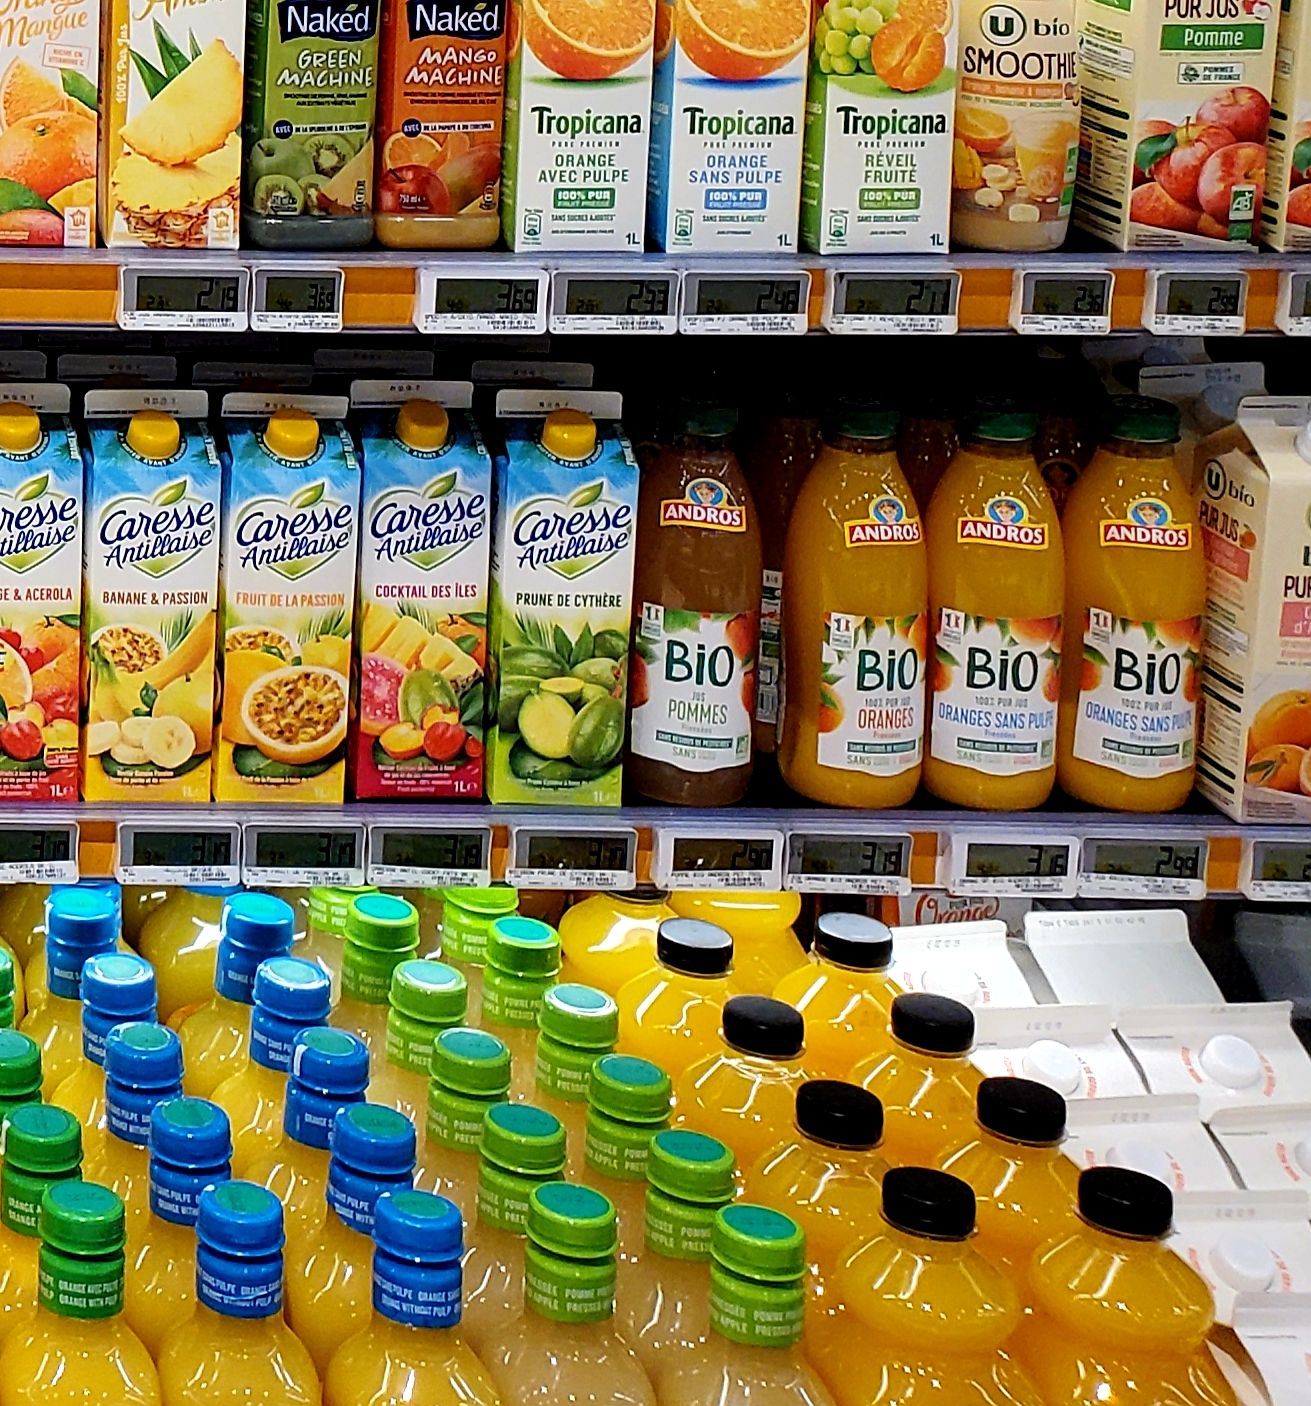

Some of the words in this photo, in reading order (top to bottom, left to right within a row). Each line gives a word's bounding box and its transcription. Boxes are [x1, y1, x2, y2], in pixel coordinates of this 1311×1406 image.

[1183, 27, 1245, 49] Pomme
[297, 49, 362, 69] GREEN
[419, 46, 497, 66] MANGO
[963, 45, 1078, 80] SMOOTHIE
[278, 66, 374, 89] MACHINE
[531, 105, 644, 140] Tropicana
[665, 504, 742, 527] ANDROS
[1106, 526, 1186, 546] ANDROS
[13, 587, 21, 601] &
[25, 587, 72, 600] ACEROLA
[376, 583, 427, 598] COCKTAIL
[430, 584, 450, 598] DES
[453, 581, 477, 598] ÎLES
[516, 592, 551, 608] PRUNE
[555, 593, 570, 607] DE
[574, 591, 622, 608] CYTHÈRE
[668, 699, 728, 725] POMMES
[938, 703, 990, 725] ORANGES
